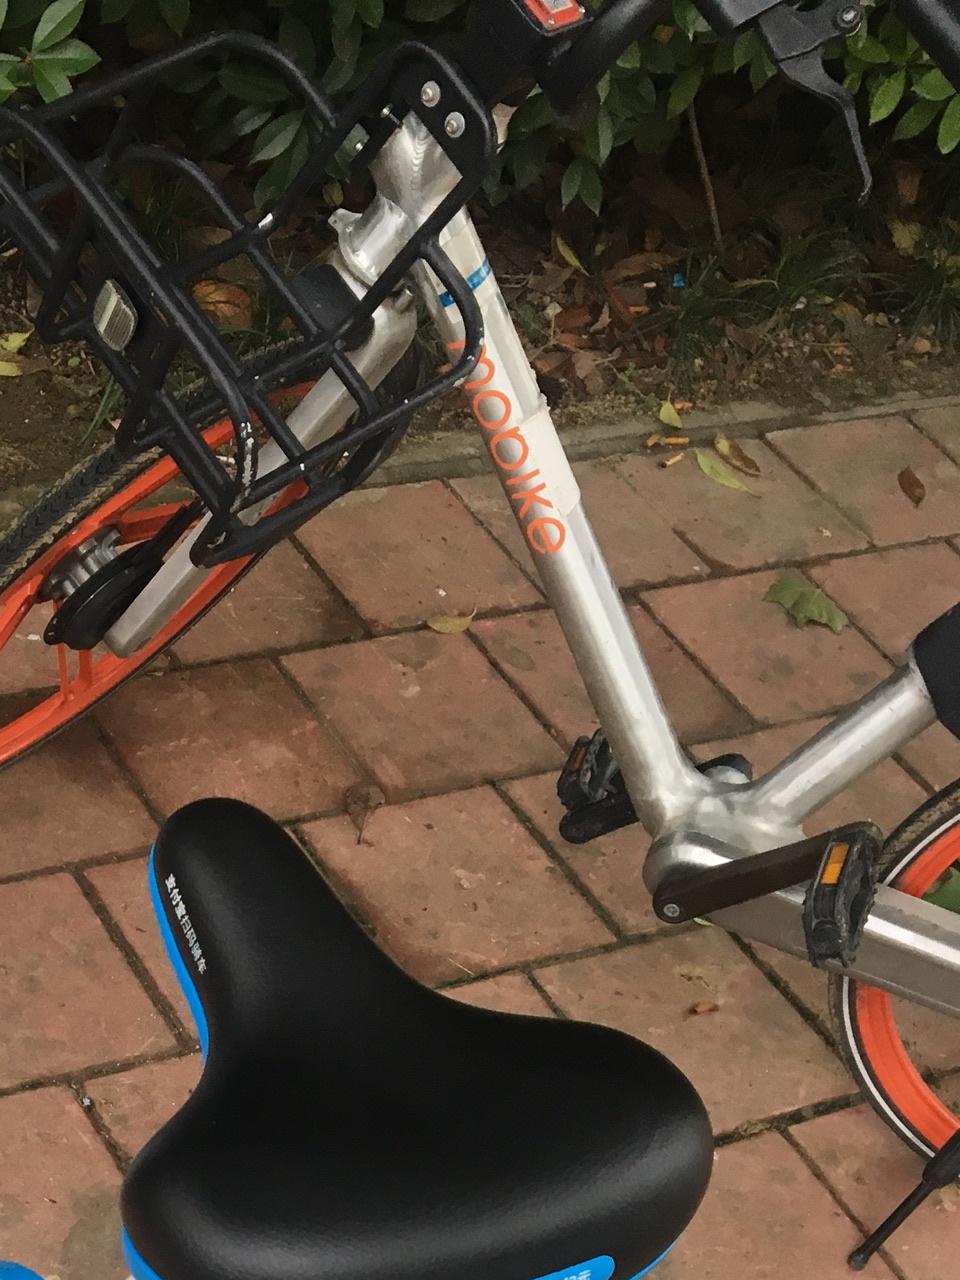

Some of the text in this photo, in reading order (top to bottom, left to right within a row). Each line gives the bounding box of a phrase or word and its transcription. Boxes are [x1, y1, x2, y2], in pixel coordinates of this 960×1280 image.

[164, 873, 208, 975] 支付宝扫码骑车
